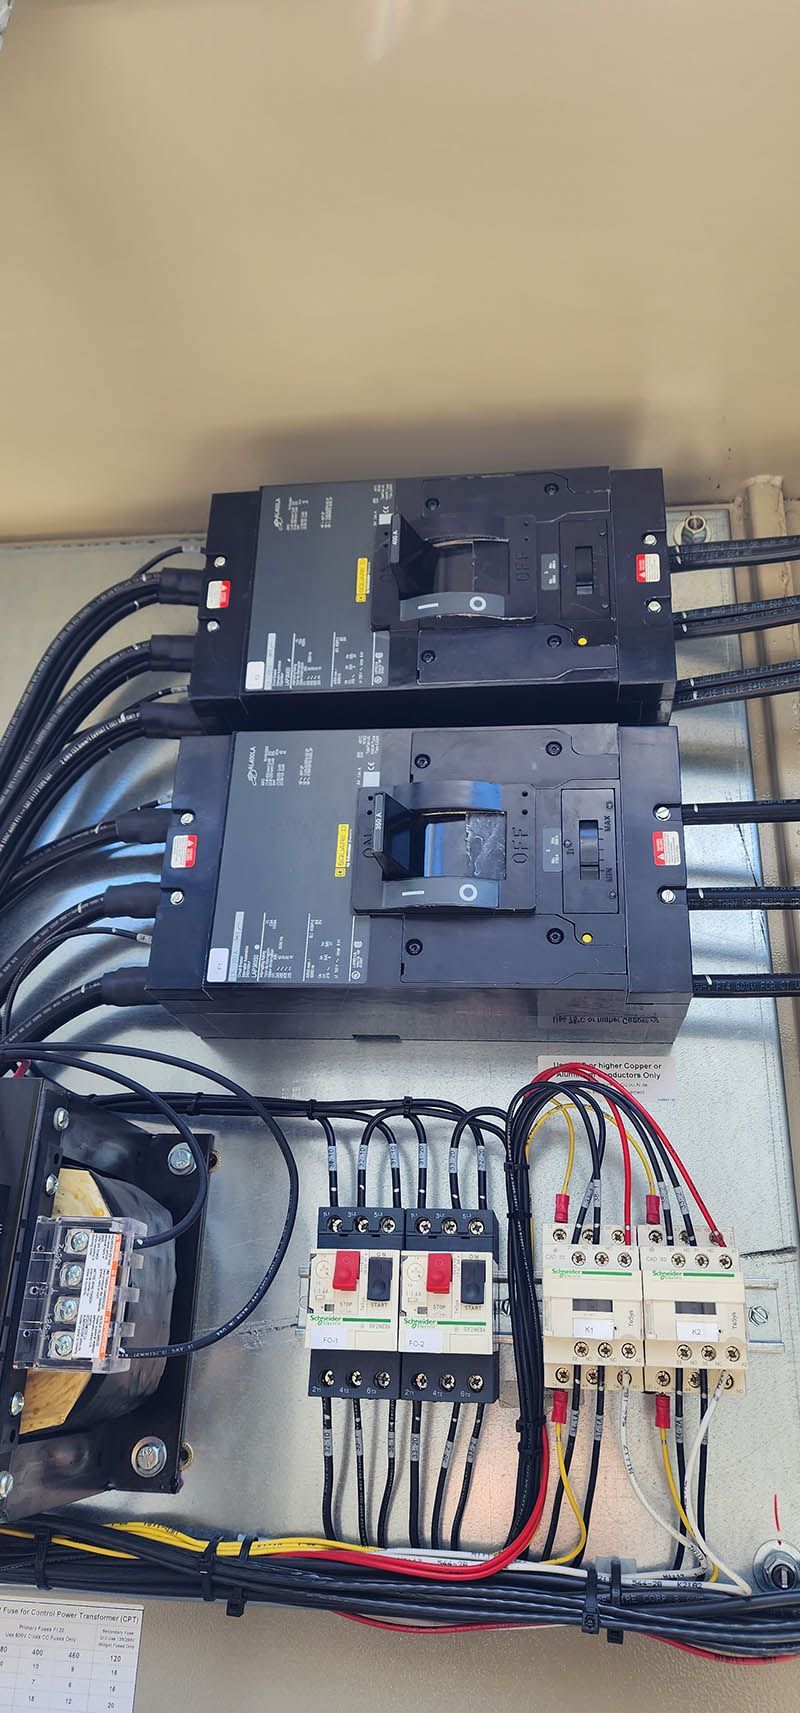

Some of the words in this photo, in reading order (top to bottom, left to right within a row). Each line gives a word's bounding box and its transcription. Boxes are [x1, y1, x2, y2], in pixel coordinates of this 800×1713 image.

[603, 816, 612, 832] MAX
[511, 826, 528, 864] OFF
[598, 1062, 622, 1071] higher
[624, 1062, 652, 1072] Copper
[642, 1072, 661, 1080] Only
[552, 1268, 581, 1278] Schneider
[652, 1270, 683, 1280] Schneider
[310, 1315, 341, 1326] Schneider
[403, 1318, 437, 1329] Schneider
[408, 1340, 425, 1348] FO-2
[3, 1607, 19, 1615] Fuse
[20, 1608, 30, 1616] for
[56, 1611, 78, 1619] Power
[79, 1612, 120, 1622] Transformer
[120, 1615, 139, 1625] (CPT)
[19, 1624, 37, 1632] Primary
[31, 1649, 44, 1657] 400
[110, 1655, 122, 1663] 120
[107, 1702, 115, 1710] 20
